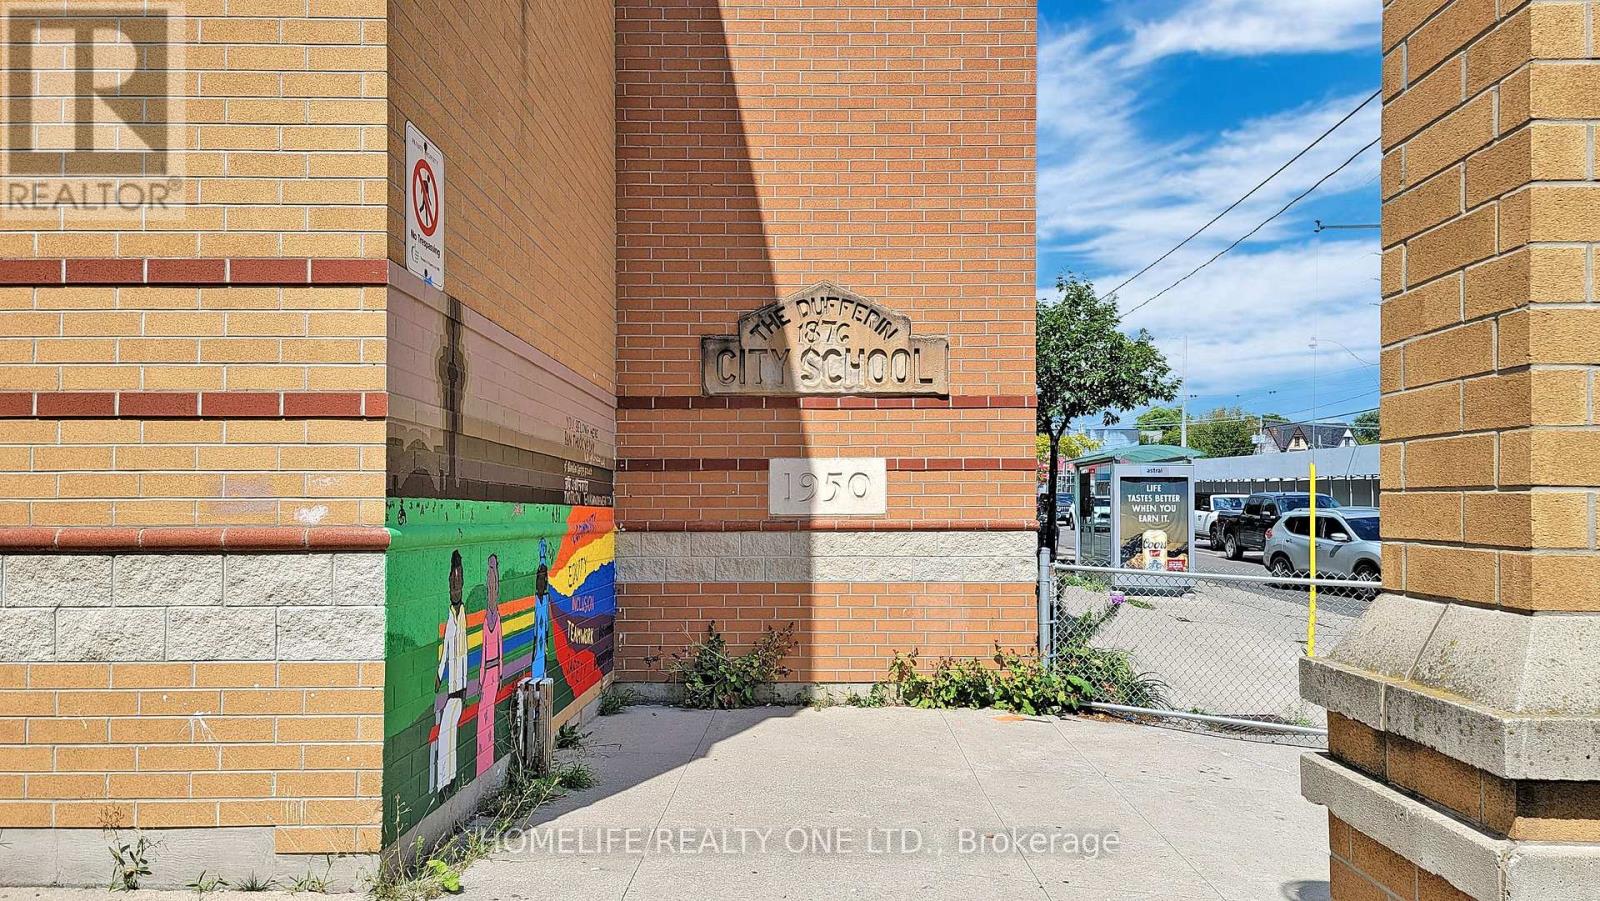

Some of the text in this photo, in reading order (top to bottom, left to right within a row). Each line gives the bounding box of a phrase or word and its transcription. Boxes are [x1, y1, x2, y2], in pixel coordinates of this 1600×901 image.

[410, 228, 441, 259] No Trespassing
[749, 296, 899, 342] THE DUFFERIN
[716, 346, 933, 387] CITY SCHOOL
[783, 472, 872, 503] 1950
[1127, 494, 1181, 503] TASTES BETTER
[1146, 484, 1162, 492] LIFE
[1132, 504, 1177, 513] WHEN YOU
[1138, 514, 1170, 523] EARN IT.
[1142, 538, 1167, 549] Coors
[567, 556, 587, 588] EQUITY
[567, 619, 595, 645] TEAMWORK
